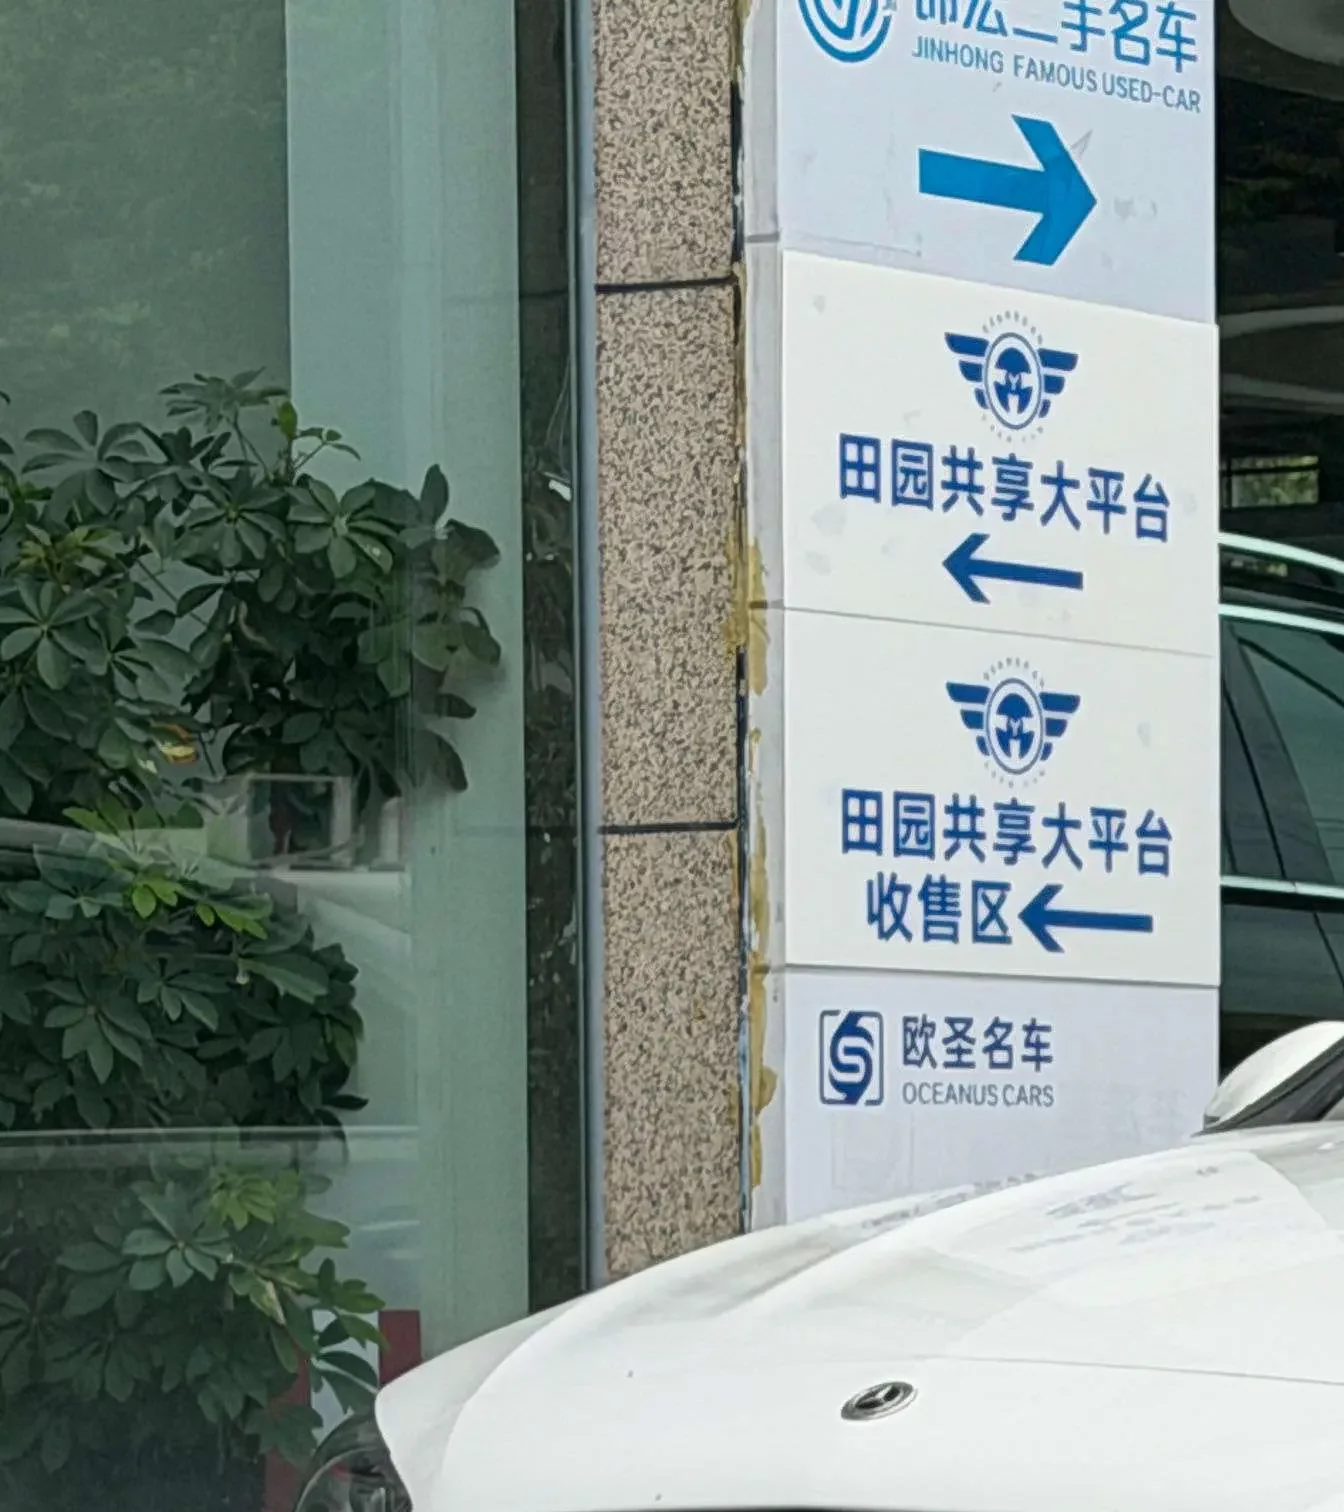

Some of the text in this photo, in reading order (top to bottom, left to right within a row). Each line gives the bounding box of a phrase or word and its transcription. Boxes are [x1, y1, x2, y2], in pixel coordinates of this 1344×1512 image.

[912, 36, 1201, 113] JINHONG FAMOUS USED-CAR
[838, 432, 1170, 543] 田园共享大平台
[841, 788, 1172, 878] 田园共享大平台
[866, 871, 1013, 945] 收售区
[902, 1014, 1054, 1073] 欧圣名车
[902, 1081, 1054, 1108] OCEANUS CARS
